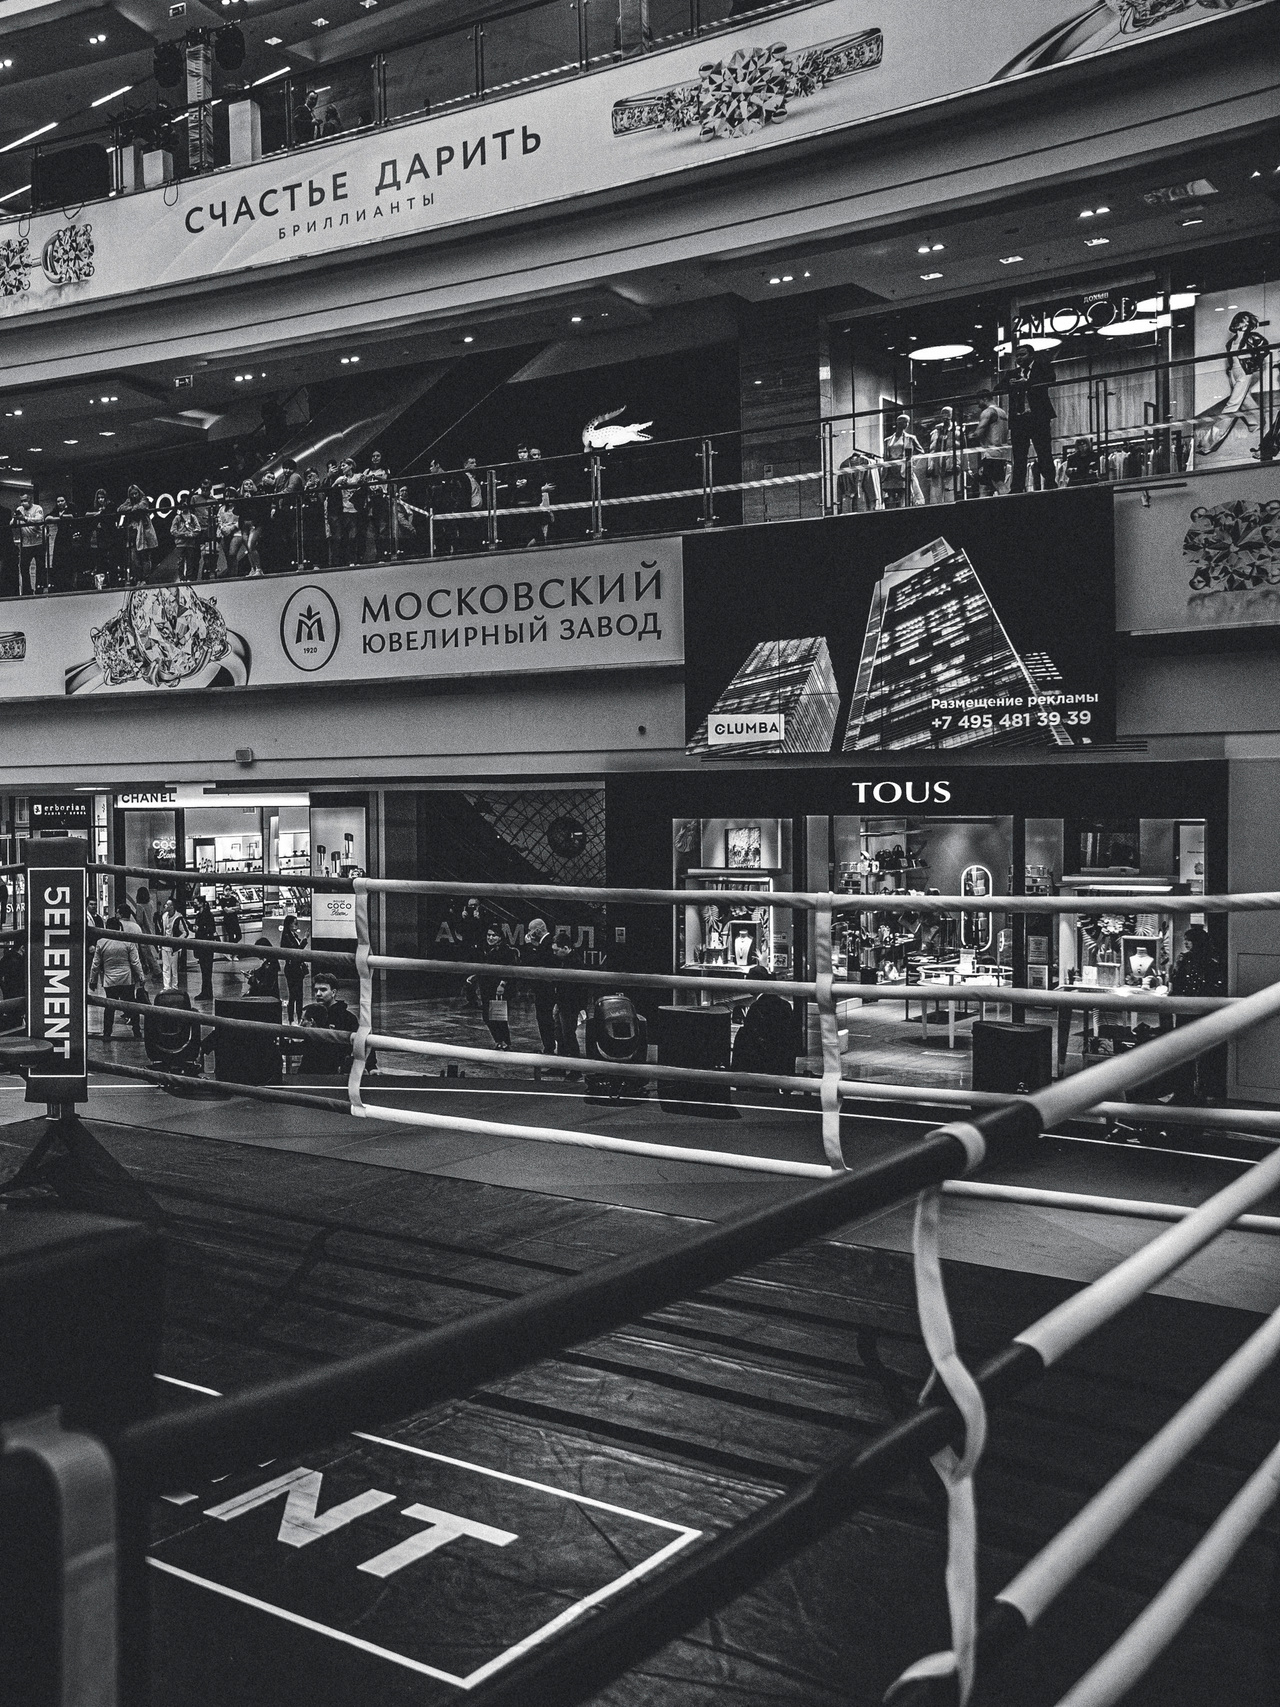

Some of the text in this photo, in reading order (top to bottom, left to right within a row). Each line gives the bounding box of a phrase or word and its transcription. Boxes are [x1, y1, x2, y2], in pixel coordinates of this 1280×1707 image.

[184, 125, 541, 233] СЧАСТЬЕ ДАРИТЬ
[278, 193, 435, 240] БРИЛЛИАНТЫ
[361, 560, 662, 624] МОСКОВСКИЙ
[362, 612, 662, 654] ЮВЕЛИРНЫЙ ЗАВОД
[303, 646, 318, 654] 1920
[931, 693, 1099, 710] Размещение рекламы
[714, 722, 779, 737] CLUMBA
[931, 709, 1092, 730] +7 495 481 39 39
[121, 793, 176, 804] CHANEL
[852, 781, 951, 804] TOUS
[153, 840, 176, 850] COC
[44, 887, 70, 1059] 5ELEMENT
[161, 1465, 520, 1578] NT
